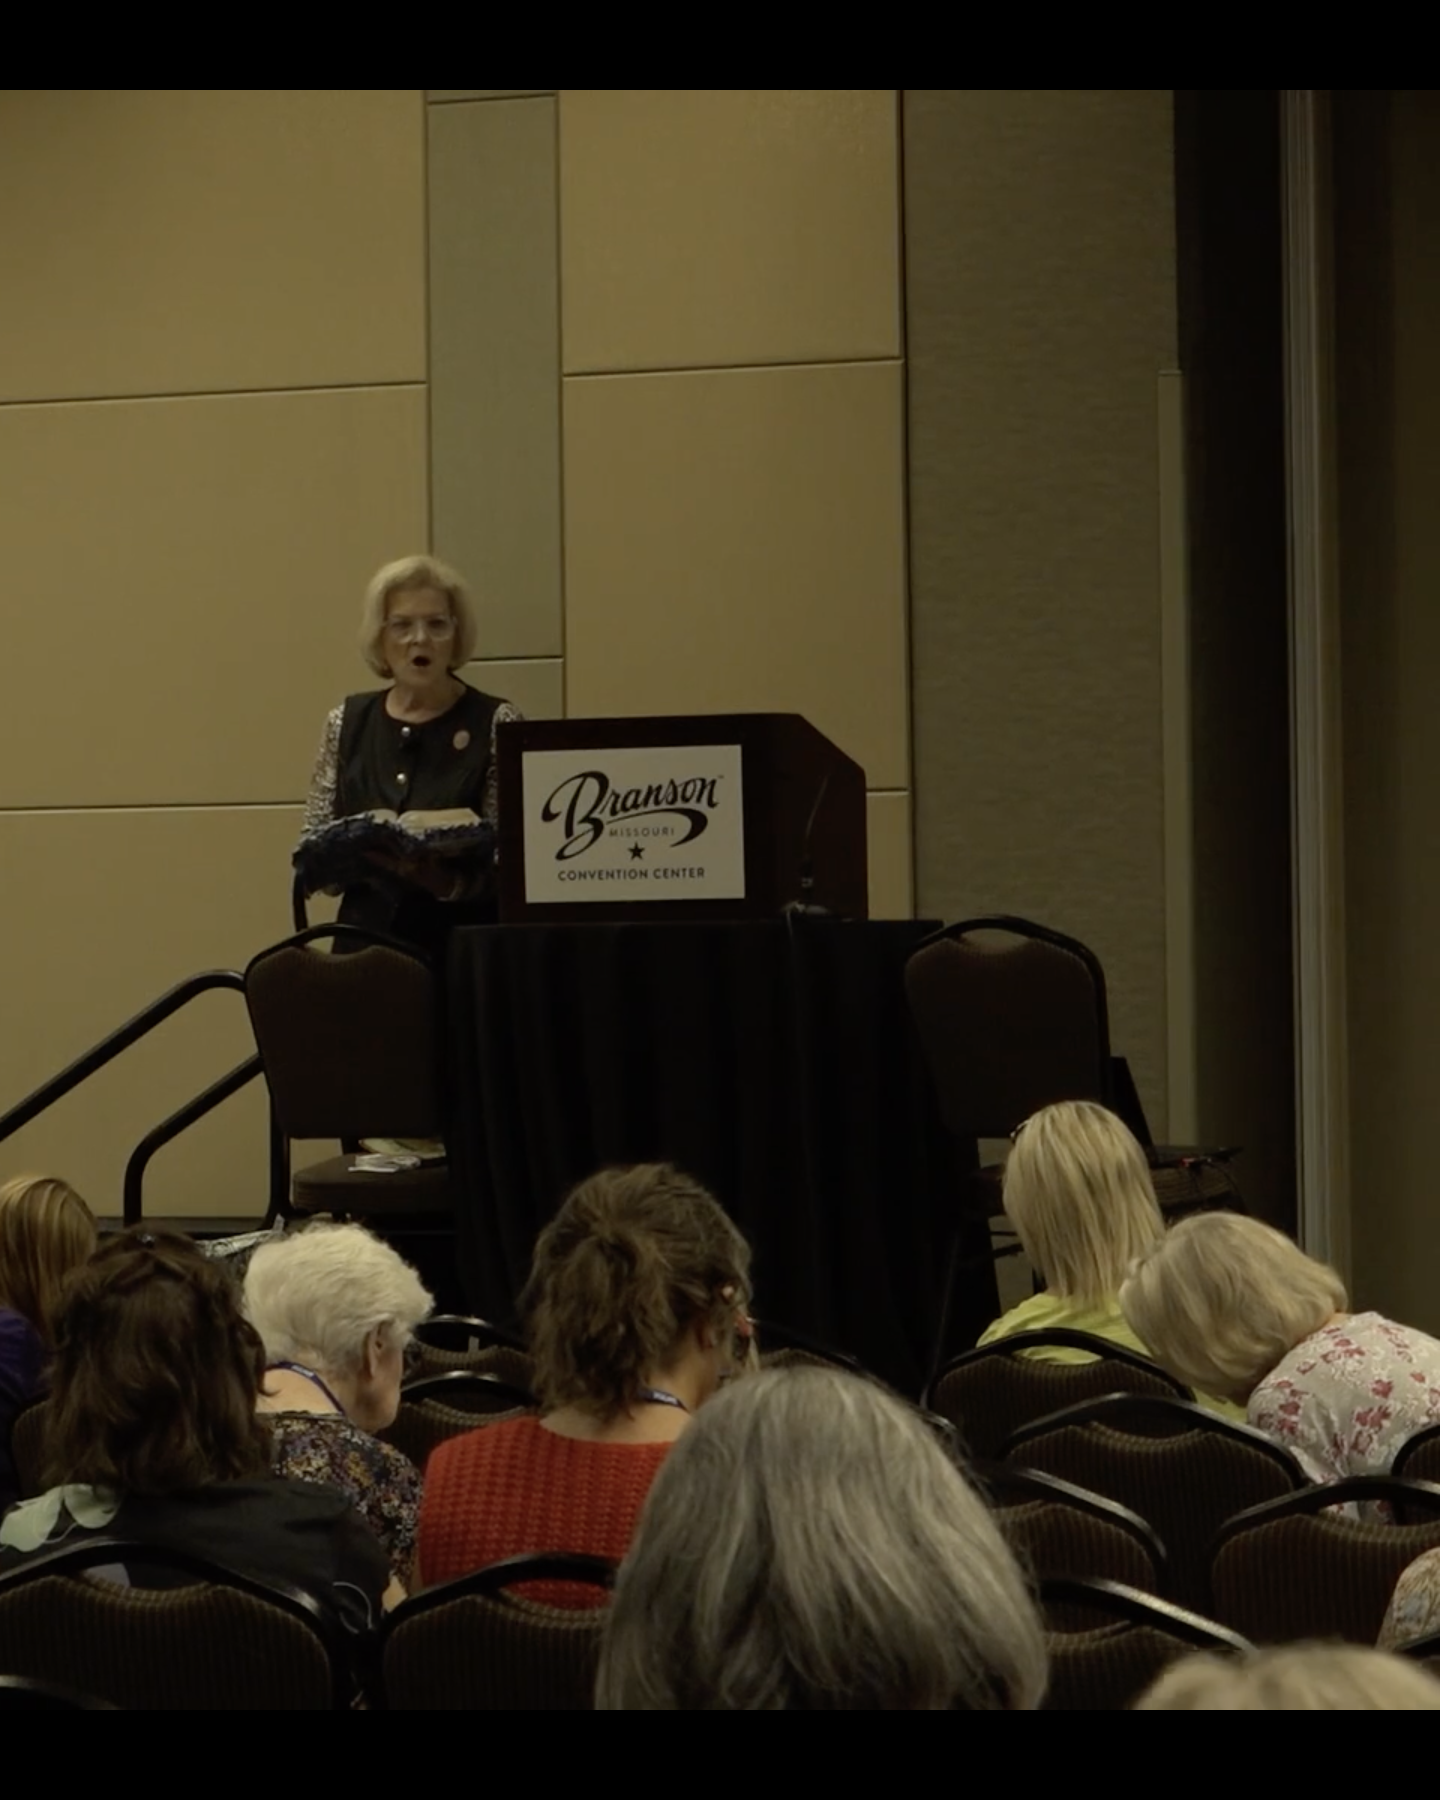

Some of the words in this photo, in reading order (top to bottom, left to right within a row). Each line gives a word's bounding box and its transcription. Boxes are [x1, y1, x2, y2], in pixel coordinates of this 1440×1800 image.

[541, 770, 720, 861] Branson
[609, 827, 675, 838] MISSOURI
[557, 869, 648, 882] CONVENTION
[653, 867, 705, 880] CENTER
